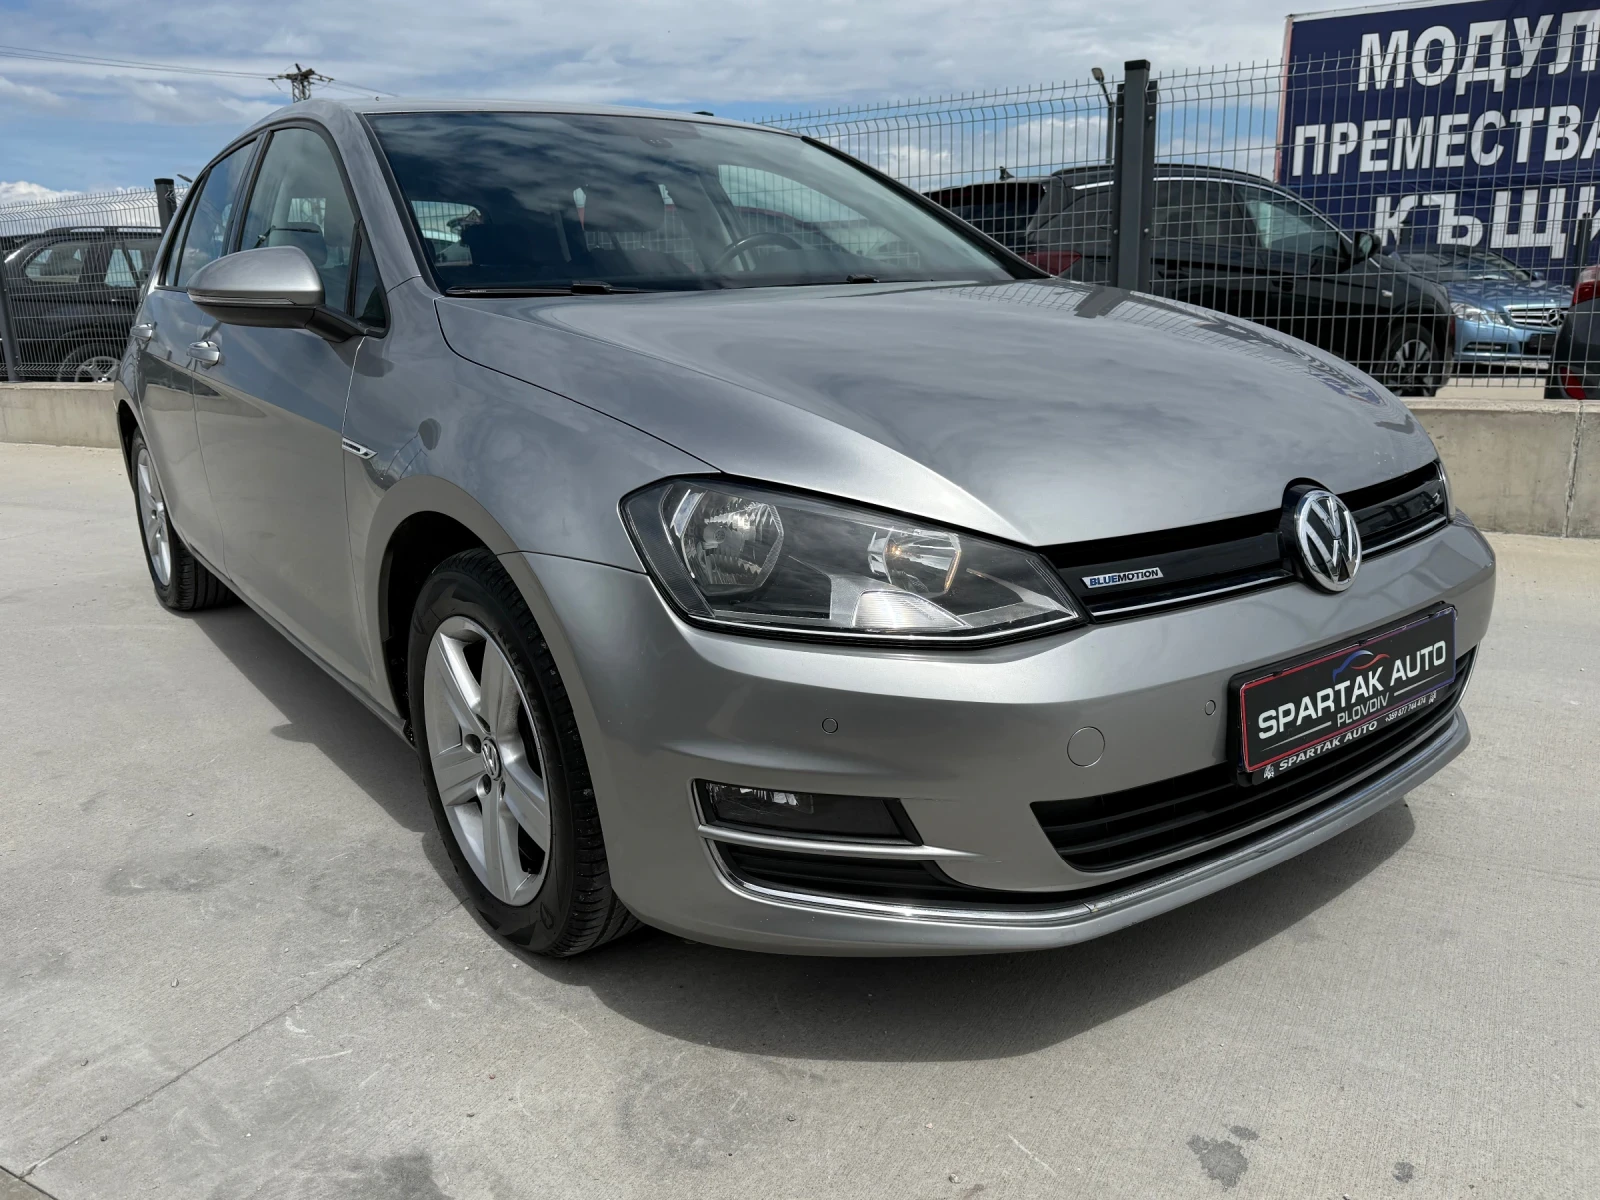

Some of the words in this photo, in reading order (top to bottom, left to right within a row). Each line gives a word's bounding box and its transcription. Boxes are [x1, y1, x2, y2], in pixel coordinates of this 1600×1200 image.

[1357, 9, 1600, 96] МОДУЛ
[1088, 568, 1160, 587] BLUEMOTION
[1258, 666, 1385, 740] SPARTAK
[1390, 640, 1447, 687] AUTO
[1337, 692, 1390, 728] PLOVDIV
[1279, 737, 1341, 771] SPARTAK
[1344, 720, 1378, 743] AUTO
